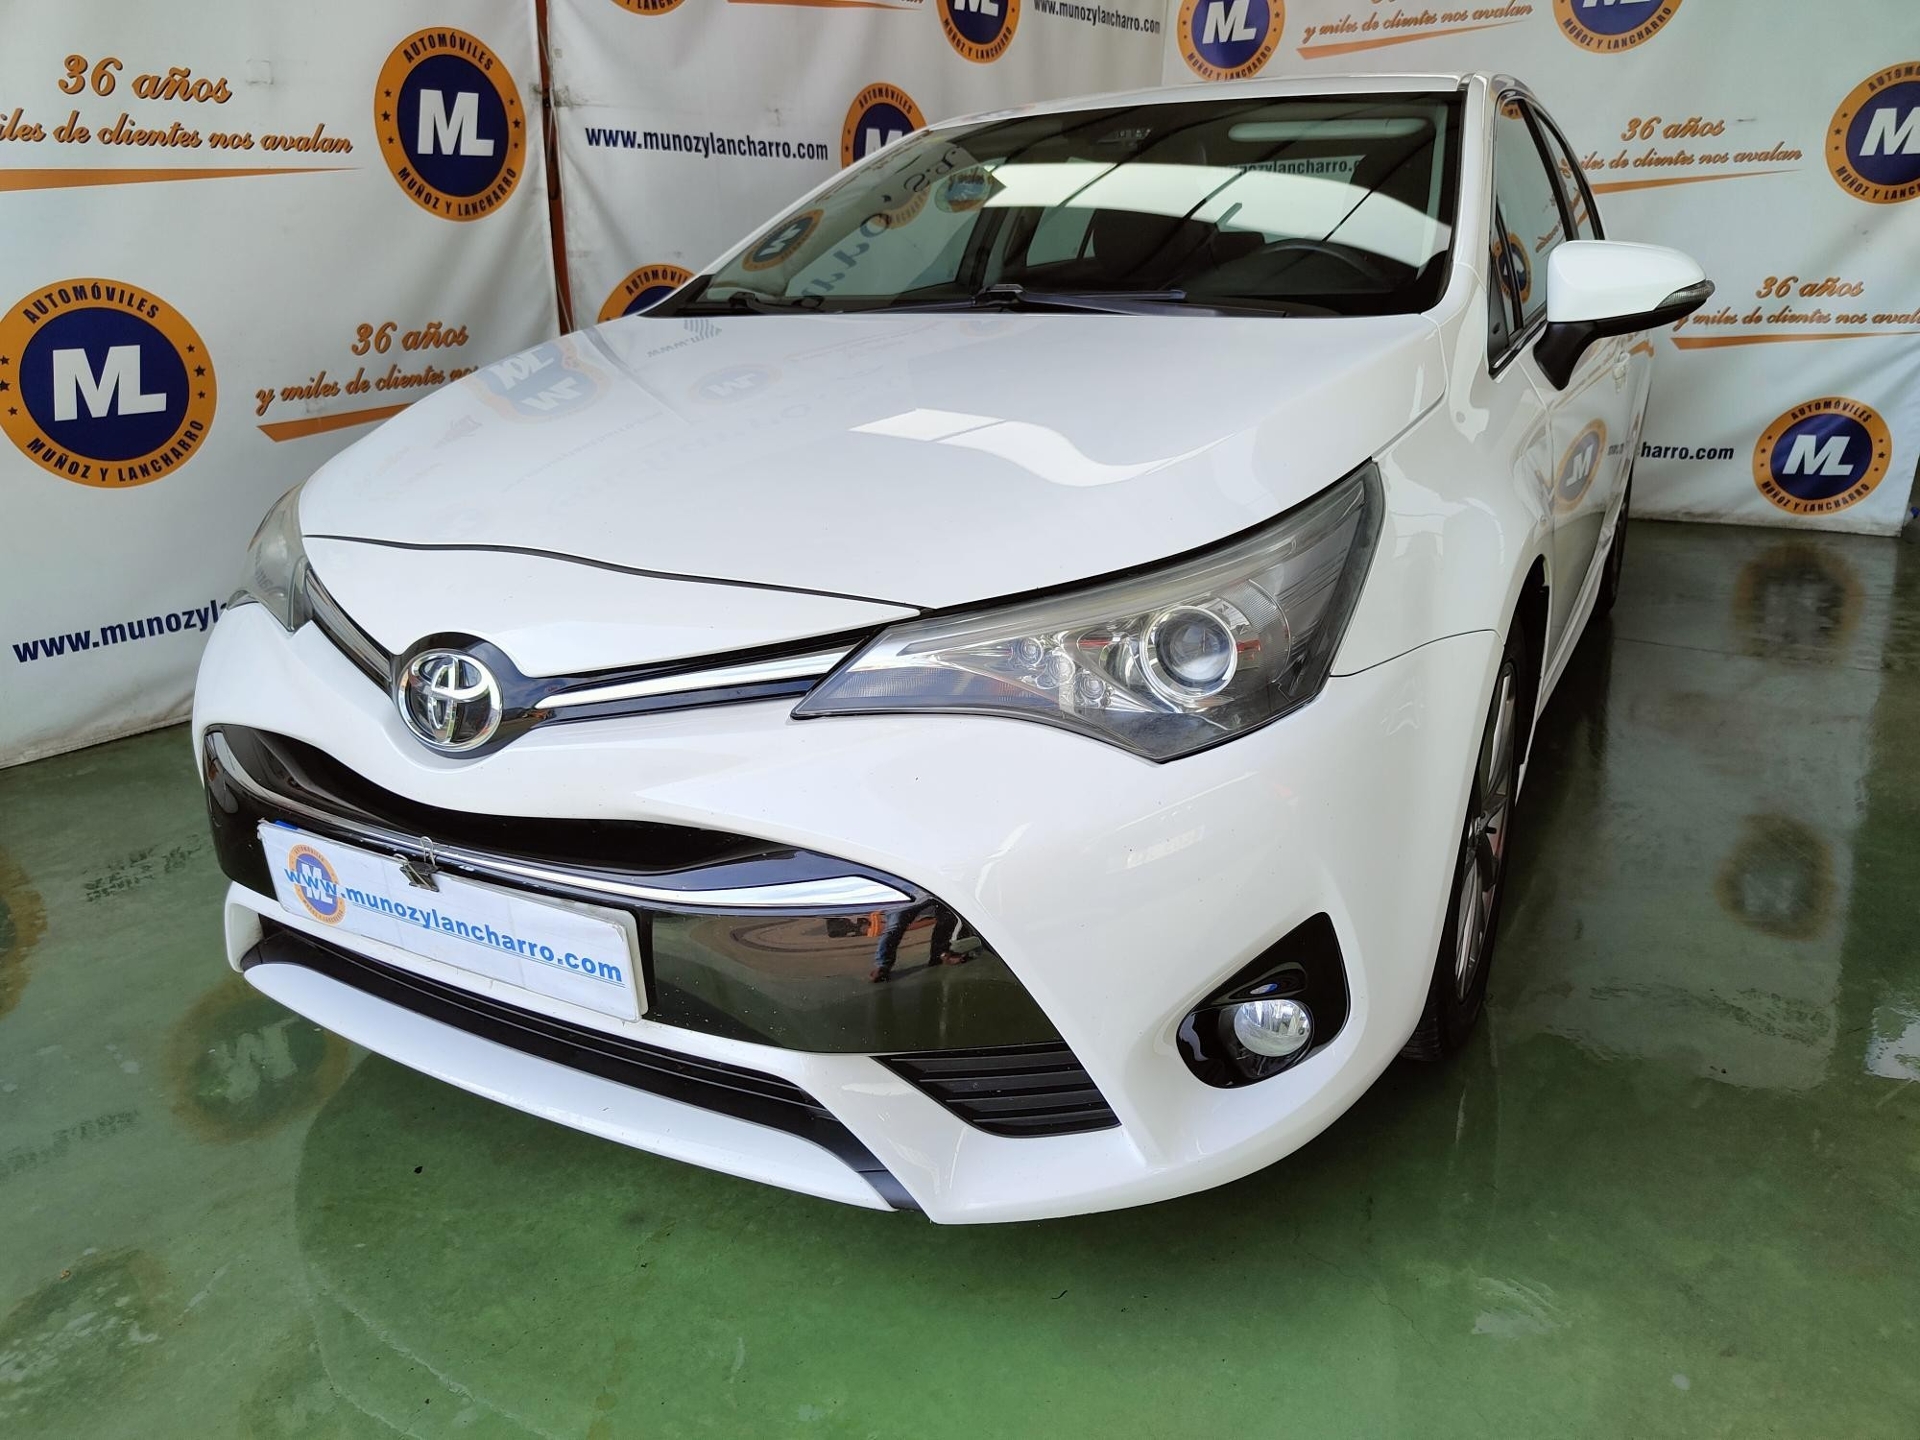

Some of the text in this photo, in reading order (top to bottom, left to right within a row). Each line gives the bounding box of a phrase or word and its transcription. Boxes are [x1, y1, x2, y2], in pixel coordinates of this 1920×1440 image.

[1202, 0, 1257, 44] ML
[1302, 0, 1533, 45] y miles de clientes nos avalan
[1595, 39, 1604, 50] Y
[1606, 6, 1672, 50] LANCHARRO
[402, 31, 494, 72] AUTOMÓVILES
[57, 54, 233, 104] 36 años
[0, 107, 354, 154] iles de clientes nos avalan
[417, 88, 495, 157] ML
[584, 126, 829, 161] www.munozylancharro.com
[1620, 115, 1726, 142] 36 años
[1858, 106, 1920, 157] M
[1580, 150, 1605, 171] iles
[1608, 149, 1629, 169] de
[1632, 147, 1695, 169] clientes
[1698, 150, 1730, 166] nos
[1733, 140, 1803, 163] avalan
[397, 166, 517, 217] MUÑOZ Y LANCHARRO
[1835, 165, 1920, 200] MUÑOZ Y LANC
[22, 281, 160, 325] AUTOMÓVILES
[1755, 275, 1865, 299] 36 años
[1692, 306, 1738, 326] miles
[1741, 306, 1762, 325] de
[1766, 305, 1831, 325] clientes
[1834, 312, 1868, 324] nos
[351, 321, 470, 356] 36 años
[52, 344, 167, 422] ML
[255, 387, 275, 416] y
[280, 370, 341, 402] miles
[345, 367, 371, 395] de
[375, 363, 446, 391] clientes
[1790, 399, 1873, 424] AUTOMÓVILES
[26, 419, 205, 482] MUÑOZ Y LANCHARRO
[1639, 441, 1735, 461] harro.com
[1781, 434, 1855, 476] ML
[12, 599, 228, 663] www.munozyl
[283, 867, 623, 983] www.munozylancharro.com
